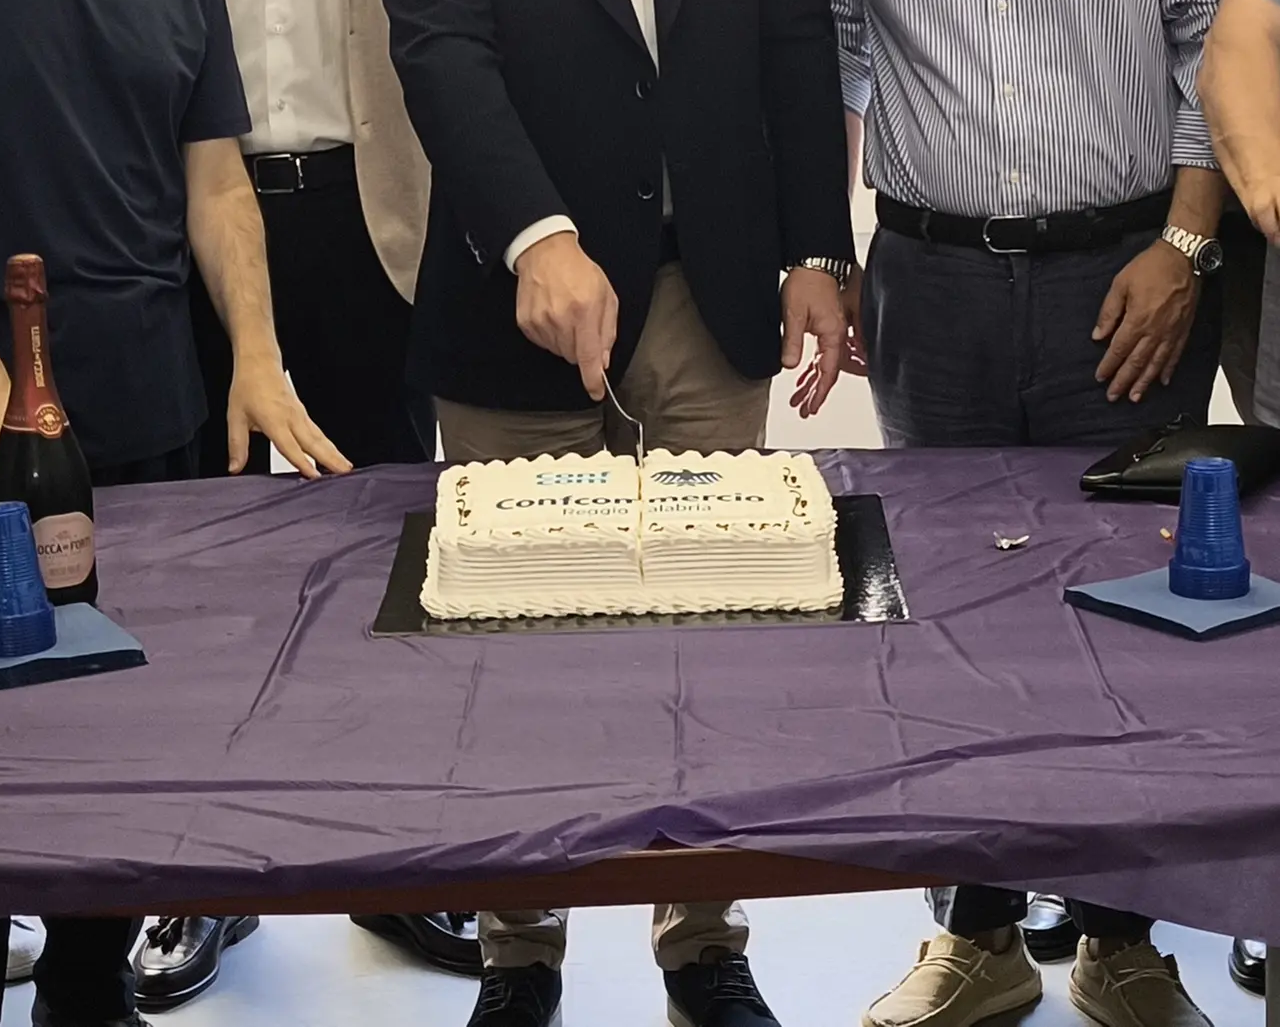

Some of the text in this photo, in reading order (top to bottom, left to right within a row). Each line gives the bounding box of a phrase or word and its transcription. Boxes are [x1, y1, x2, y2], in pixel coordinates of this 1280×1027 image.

[562, 503, 713, 517] Reggio alabria
[37, 544, 63, 555] OCCA
